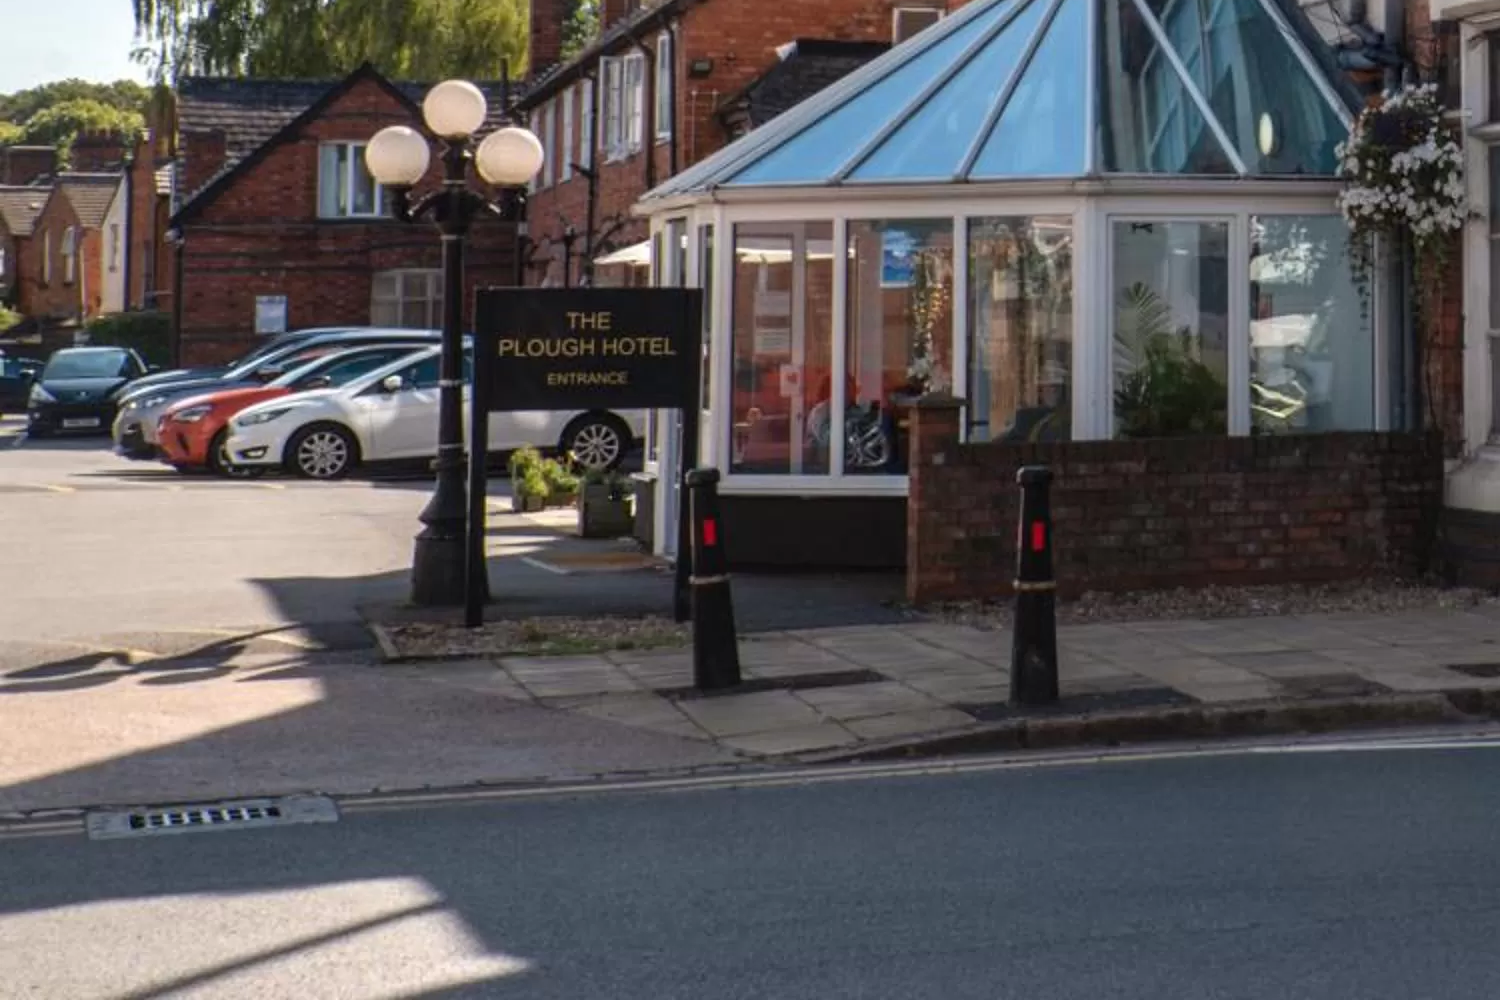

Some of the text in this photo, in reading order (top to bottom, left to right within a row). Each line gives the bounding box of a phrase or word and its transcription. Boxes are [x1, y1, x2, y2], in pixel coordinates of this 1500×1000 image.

[566, 311, 612, 330] THE
[498, 336, 677, 358] PLOUGH HOTEL
[546, 370, 630, 386] ENTRANCE
